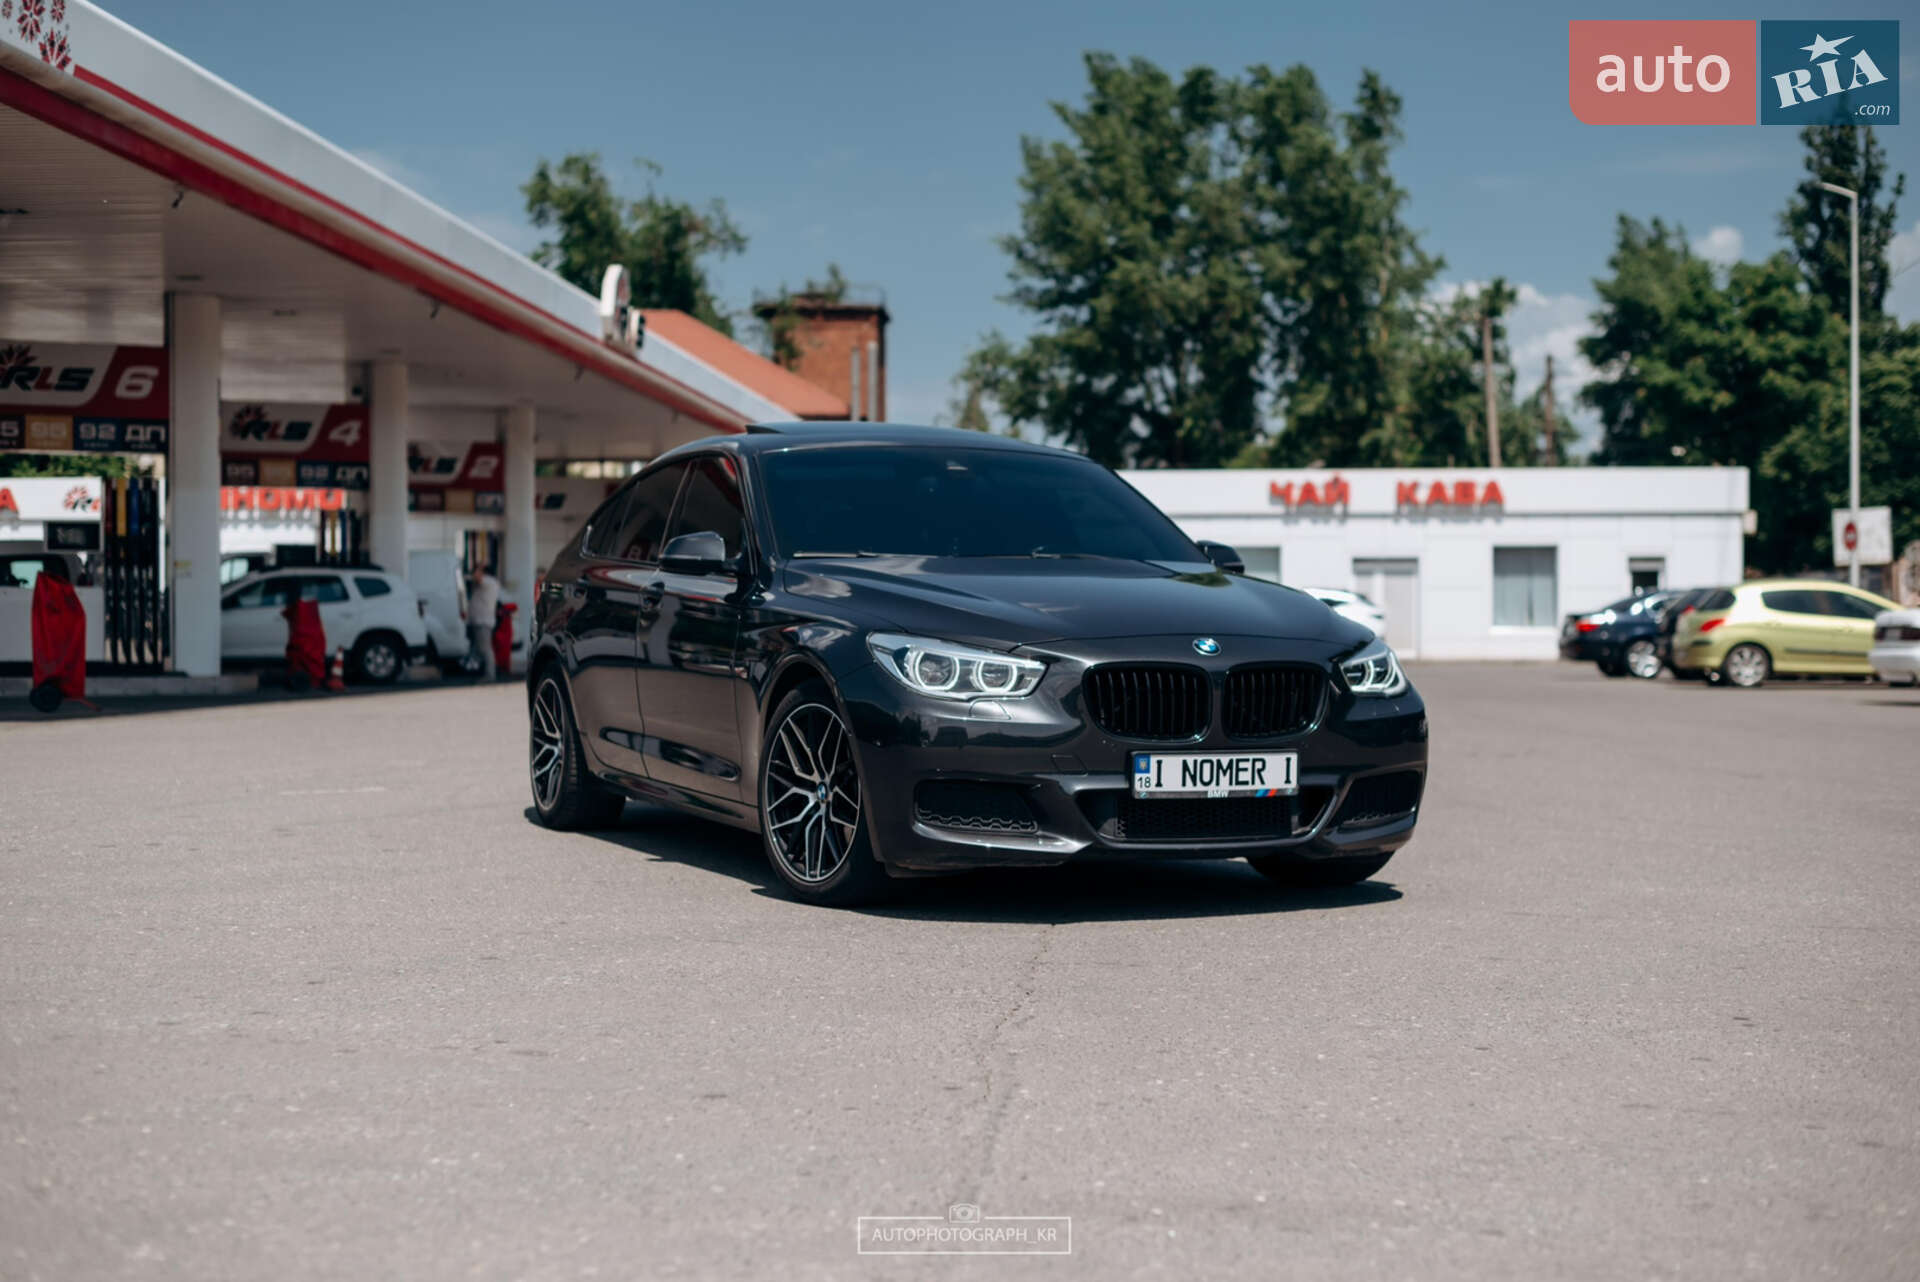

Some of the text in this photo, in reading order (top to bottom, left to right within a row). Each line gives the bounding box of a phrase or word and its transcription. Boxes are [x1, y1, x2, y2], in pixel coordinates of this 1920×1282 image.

[0, 365, 160, 399] RLS 6
[79, 423, 116, 441] 92
[328, 419, 362, 446] 4
[1269, 472, 1504, 506] ЧАЙ КАВА
[1137, 776, 1151, 789] 18
[1181, 758, 1266, 788] NOMER
[1207, 790, 1229, 799] BMW
